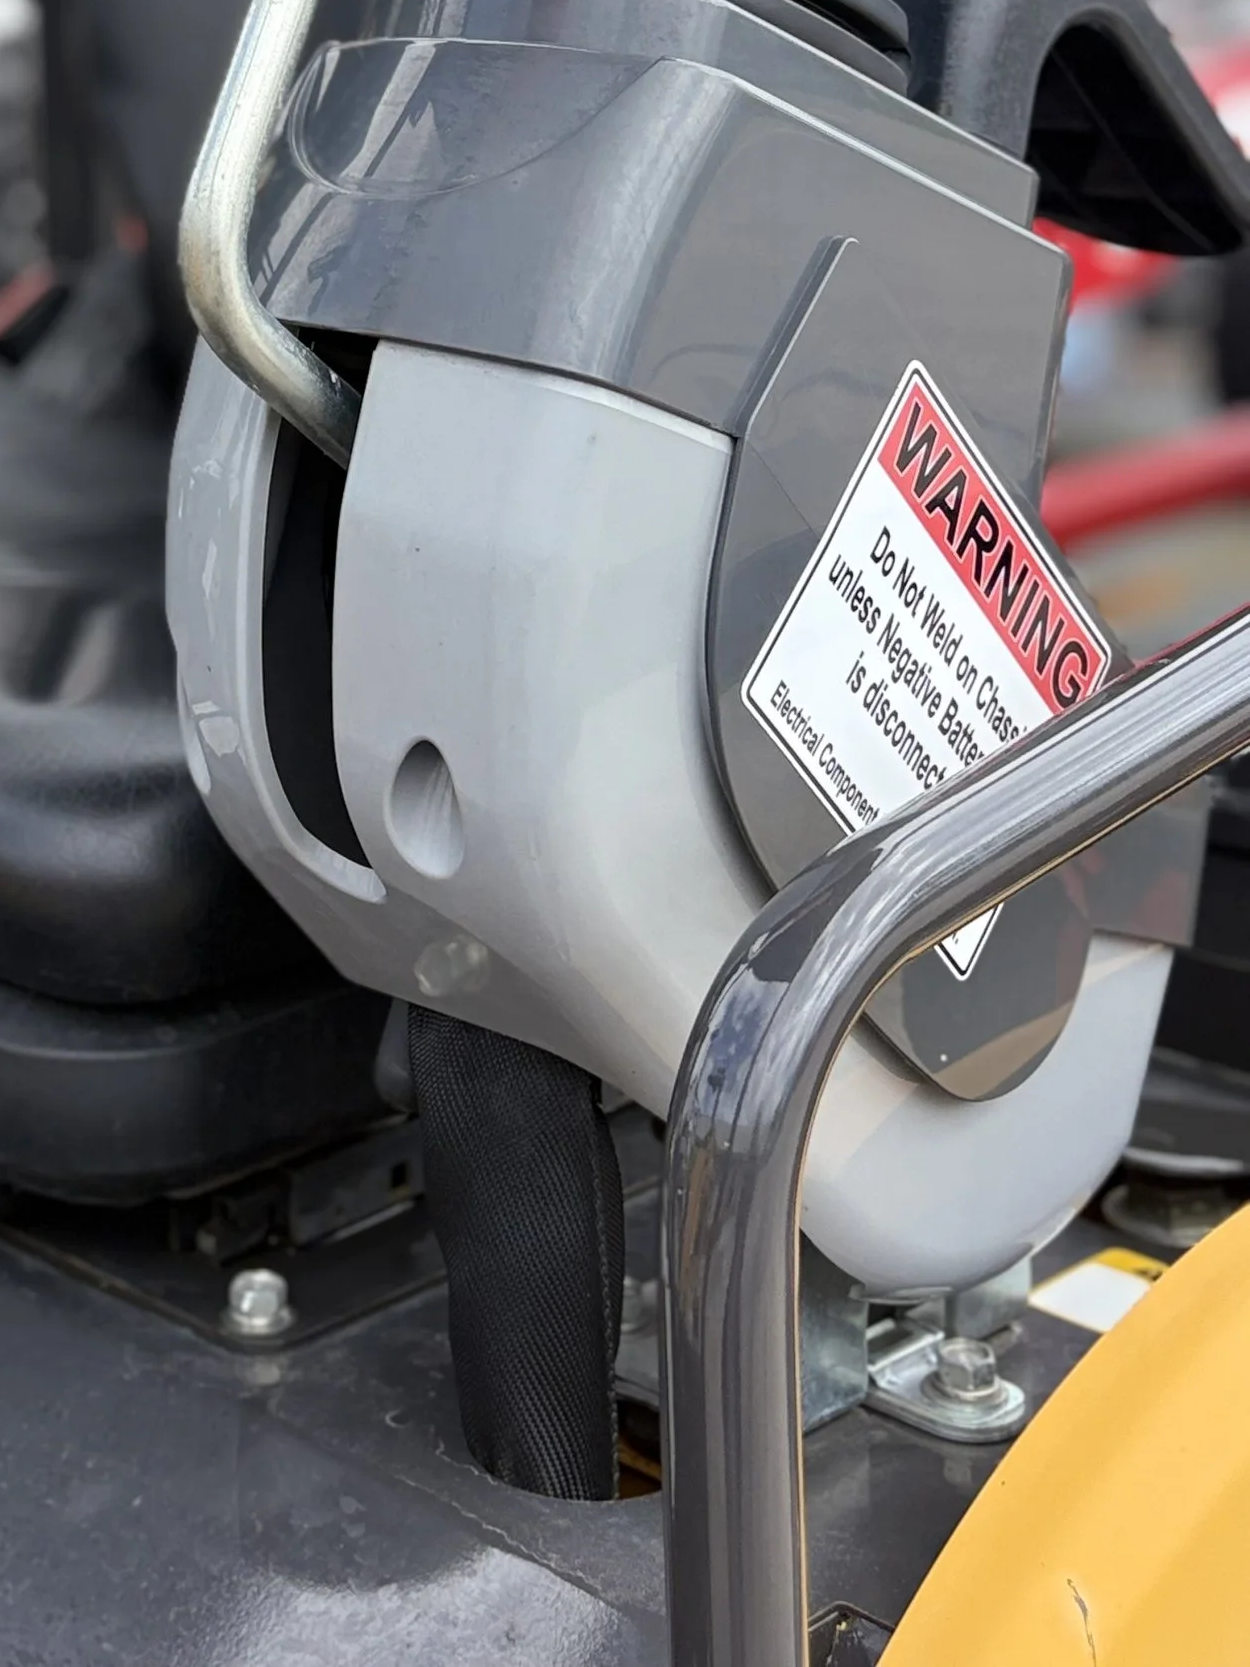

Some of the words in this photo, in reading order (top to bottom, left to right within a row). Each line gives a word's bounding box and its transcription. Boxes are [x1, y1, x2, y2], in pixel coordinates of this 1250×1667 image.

[828, 554, 881, 634] unless
[876, 612, 942, 719] Negative
[870, 525, 896, 577] Do
[892, 556, 927, 619] Not
[920, 592, 963, 667] Weld
[956, 655, 978, 695] on
[975, 675, 1028, 743] Chass
[896, 401, 1088, 709] WARNING
[770, 679, 825, 757] Electrical
[846, 650, 867, 694] is
